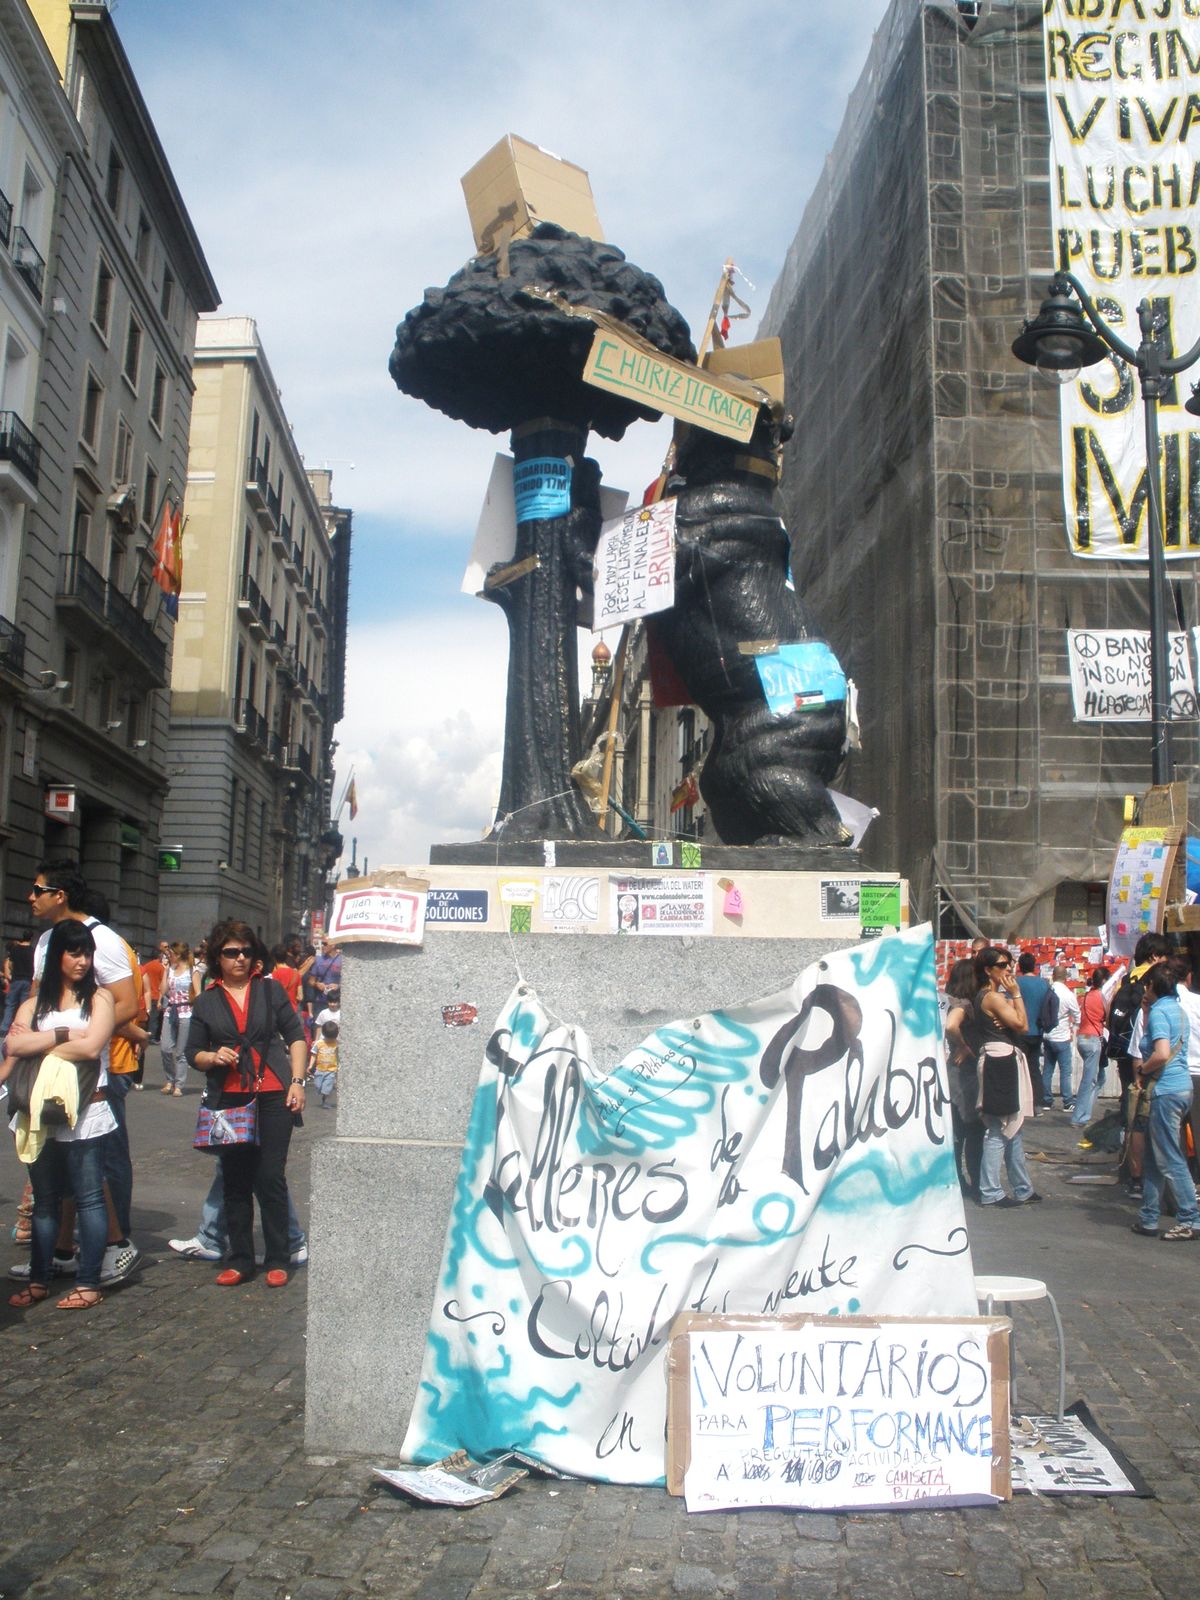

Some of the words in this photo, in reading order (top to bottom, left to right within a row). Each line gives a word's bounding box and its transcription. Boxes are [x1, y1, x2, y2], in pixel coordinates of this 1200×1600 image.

[594, 339, 753, 428] CHORIZOCRACIA
[636, 522, 650, 537] EL
[634, 537, 648, 580] FINAL
[605, 565, 617, 585] MUY
[601, 588, 617, 617] POR
[633, 590, 646, 609] AL
[1105, 636, 1184, 657] BANS
[427, 892, 459, 900] PLAZA
[345, 910, 370, 922] Spain
[425, 906, 484, 920] SOLUCIONES
[711, 1084, 743, 1164] de
[596, 1411, 641, 1459] en
[696, 1414, 749, 1431] PARA
[757, 1403, 994, 1458] PERFORMANCE
[716, 1463, 729, 1481] A
[885, 1466, 944, 1485] CAMISETA
